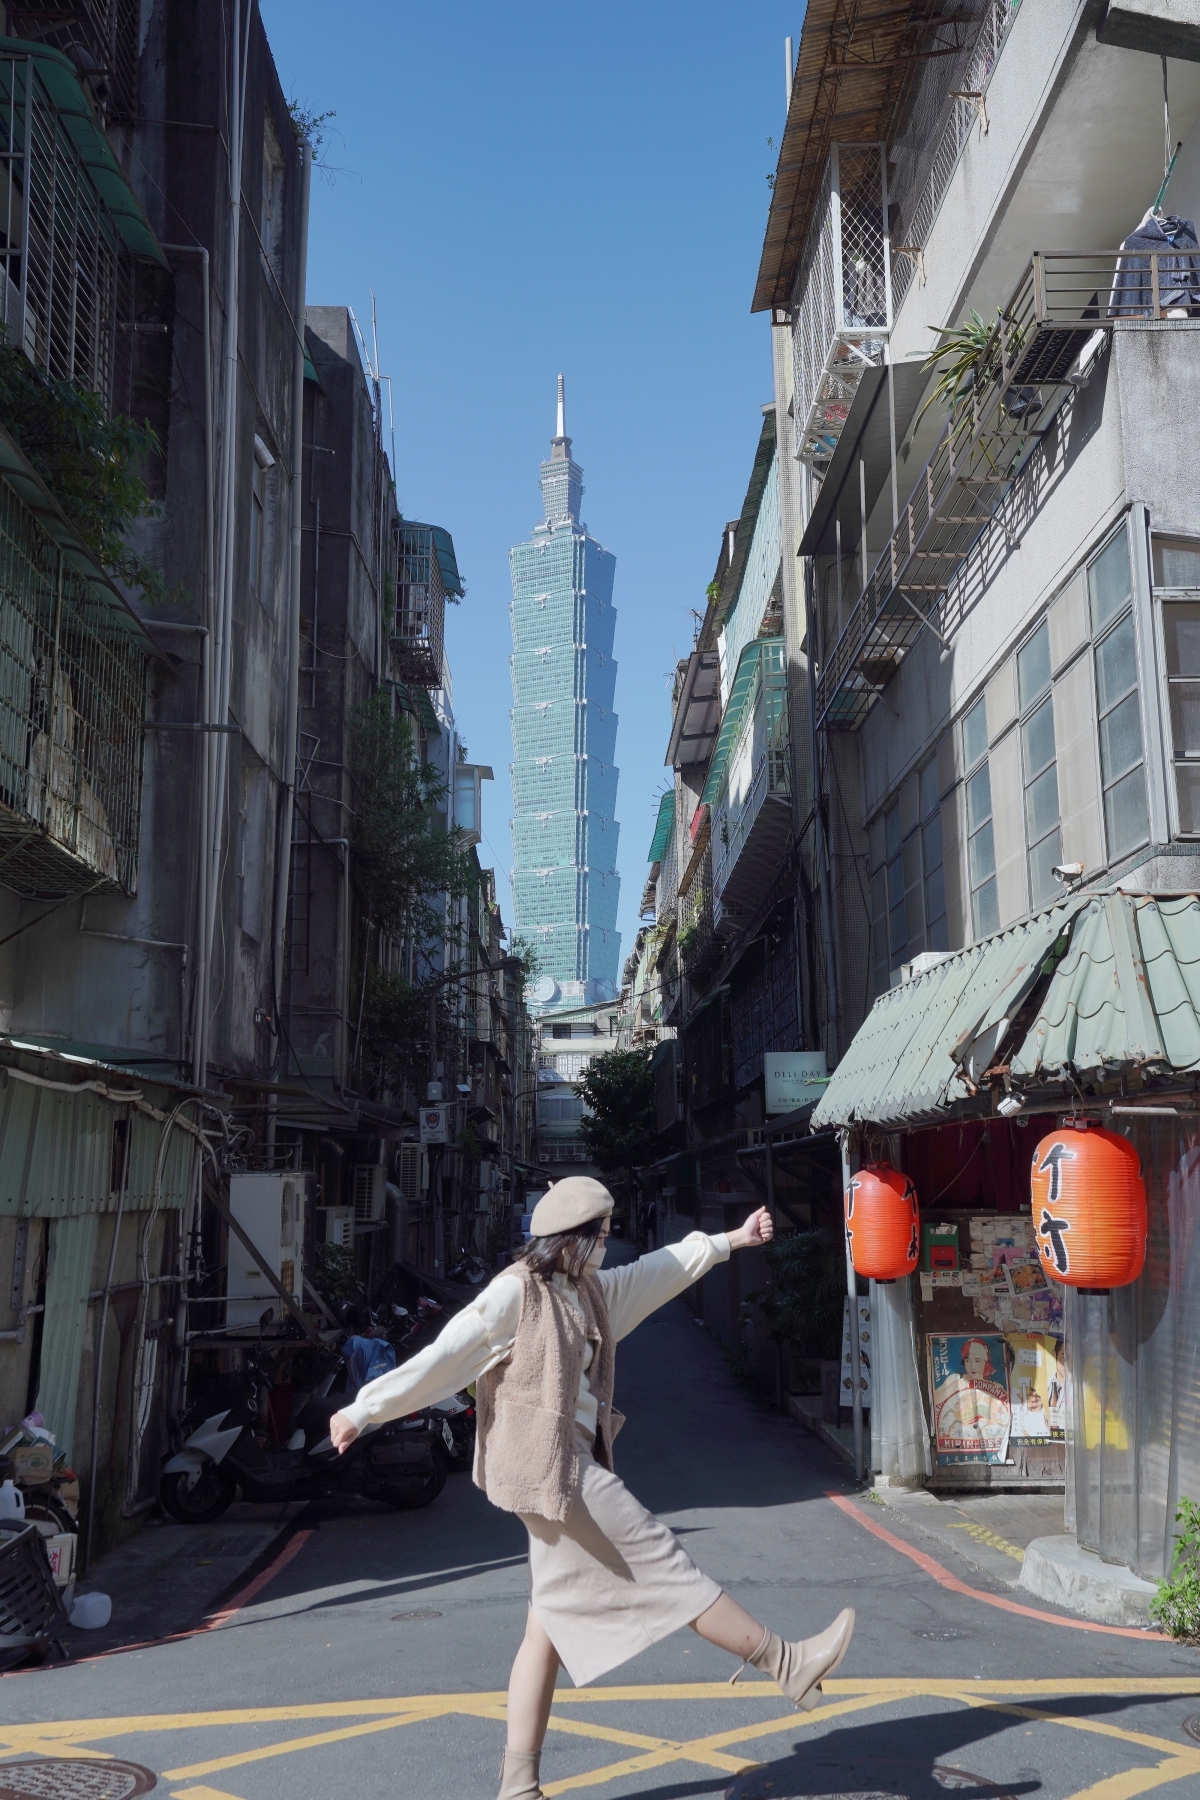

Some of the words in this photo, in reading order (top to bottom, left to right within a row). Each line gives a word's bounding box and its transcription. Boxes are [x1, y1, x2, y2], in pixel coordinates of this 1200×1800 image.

[939, 1337, 950, 1376] キリンビール
[974, 1380, 1007, 1400] COMPANY
